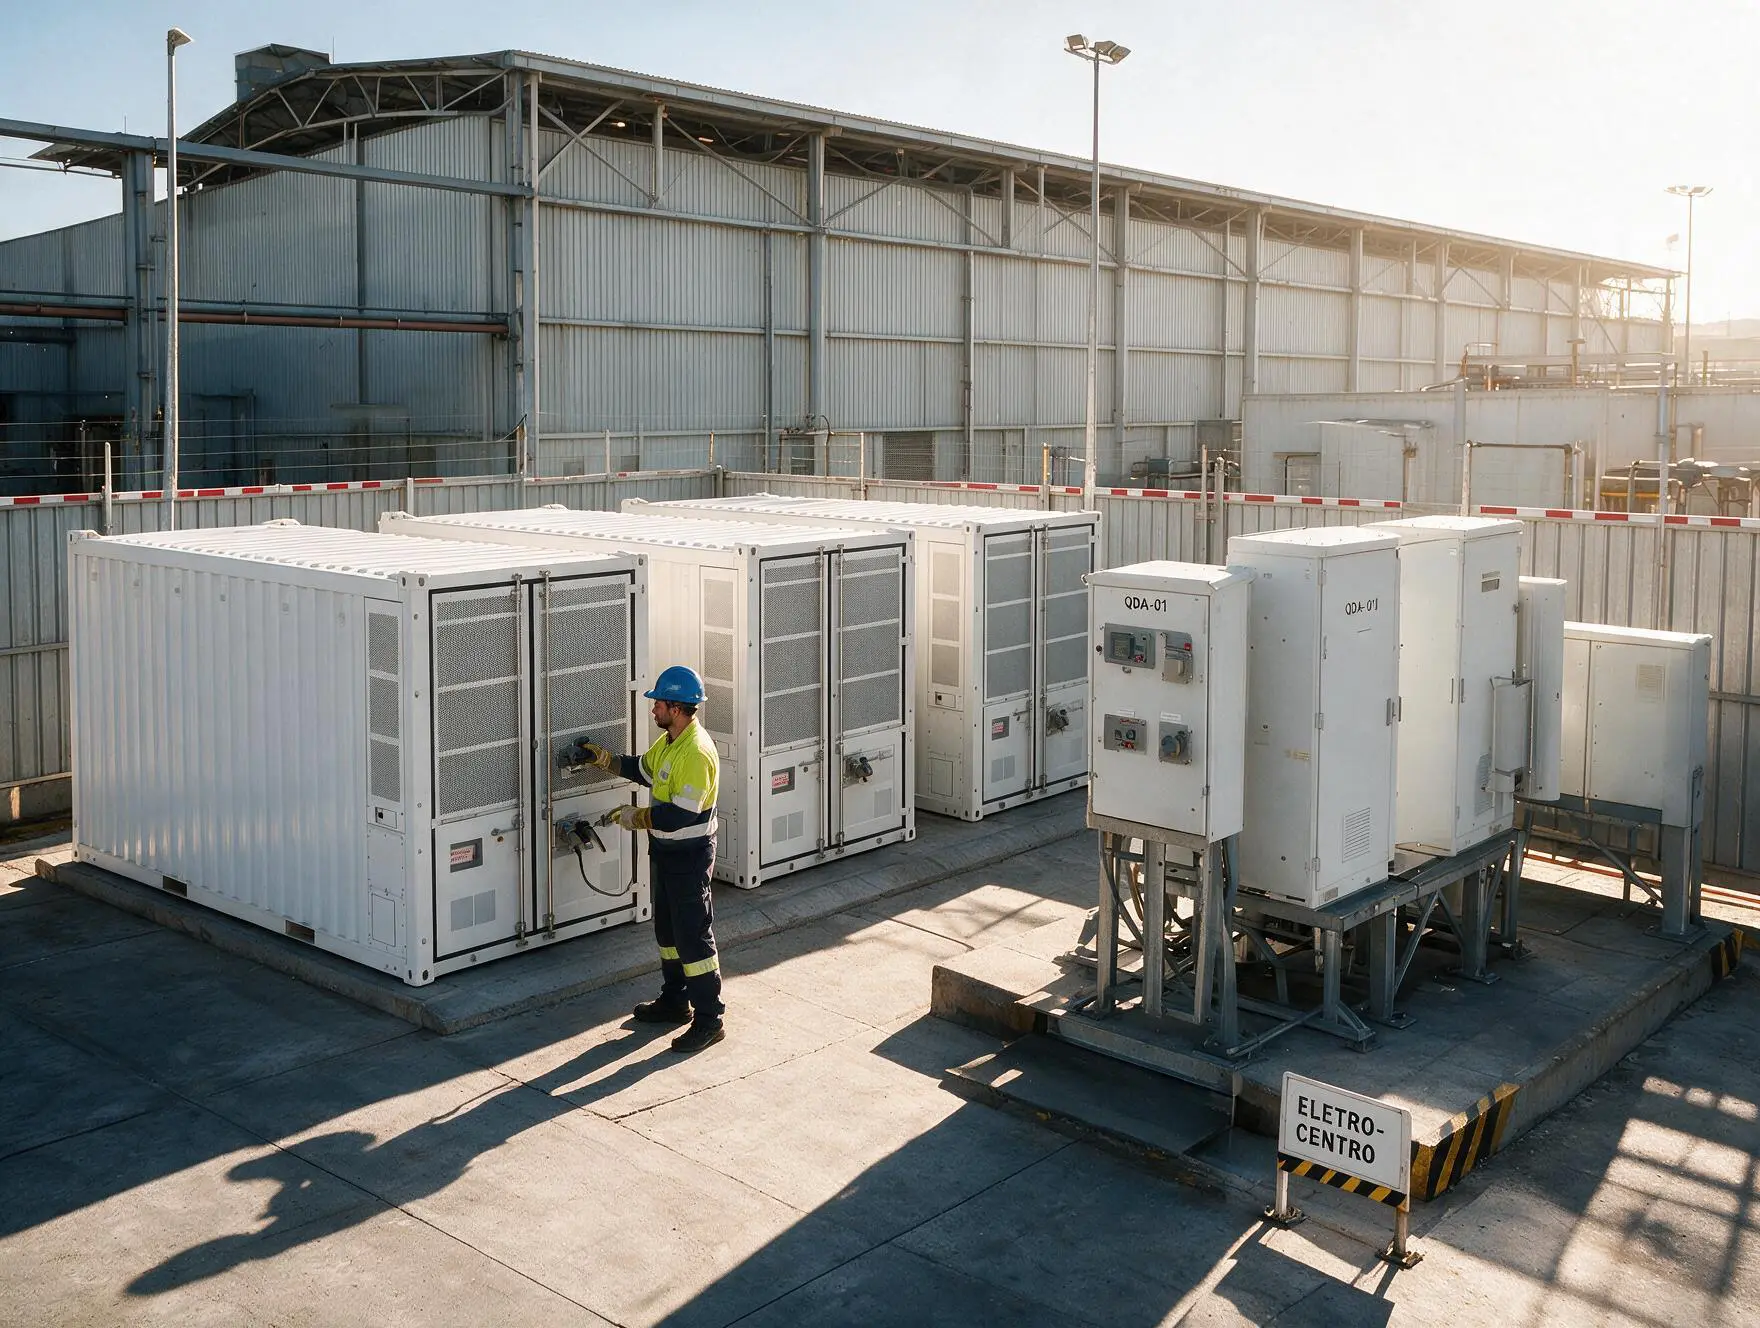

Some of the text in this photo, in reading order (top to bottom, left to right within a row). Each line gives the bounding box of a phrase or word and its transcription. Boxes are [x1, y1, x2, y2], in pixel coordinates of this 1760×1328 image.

[1124, 596, 1167, 612] QDA-01
[1298, 1095, 1385, 1136] ELETRO-
[1296, 1123, 1375, 1164] CENTRO
